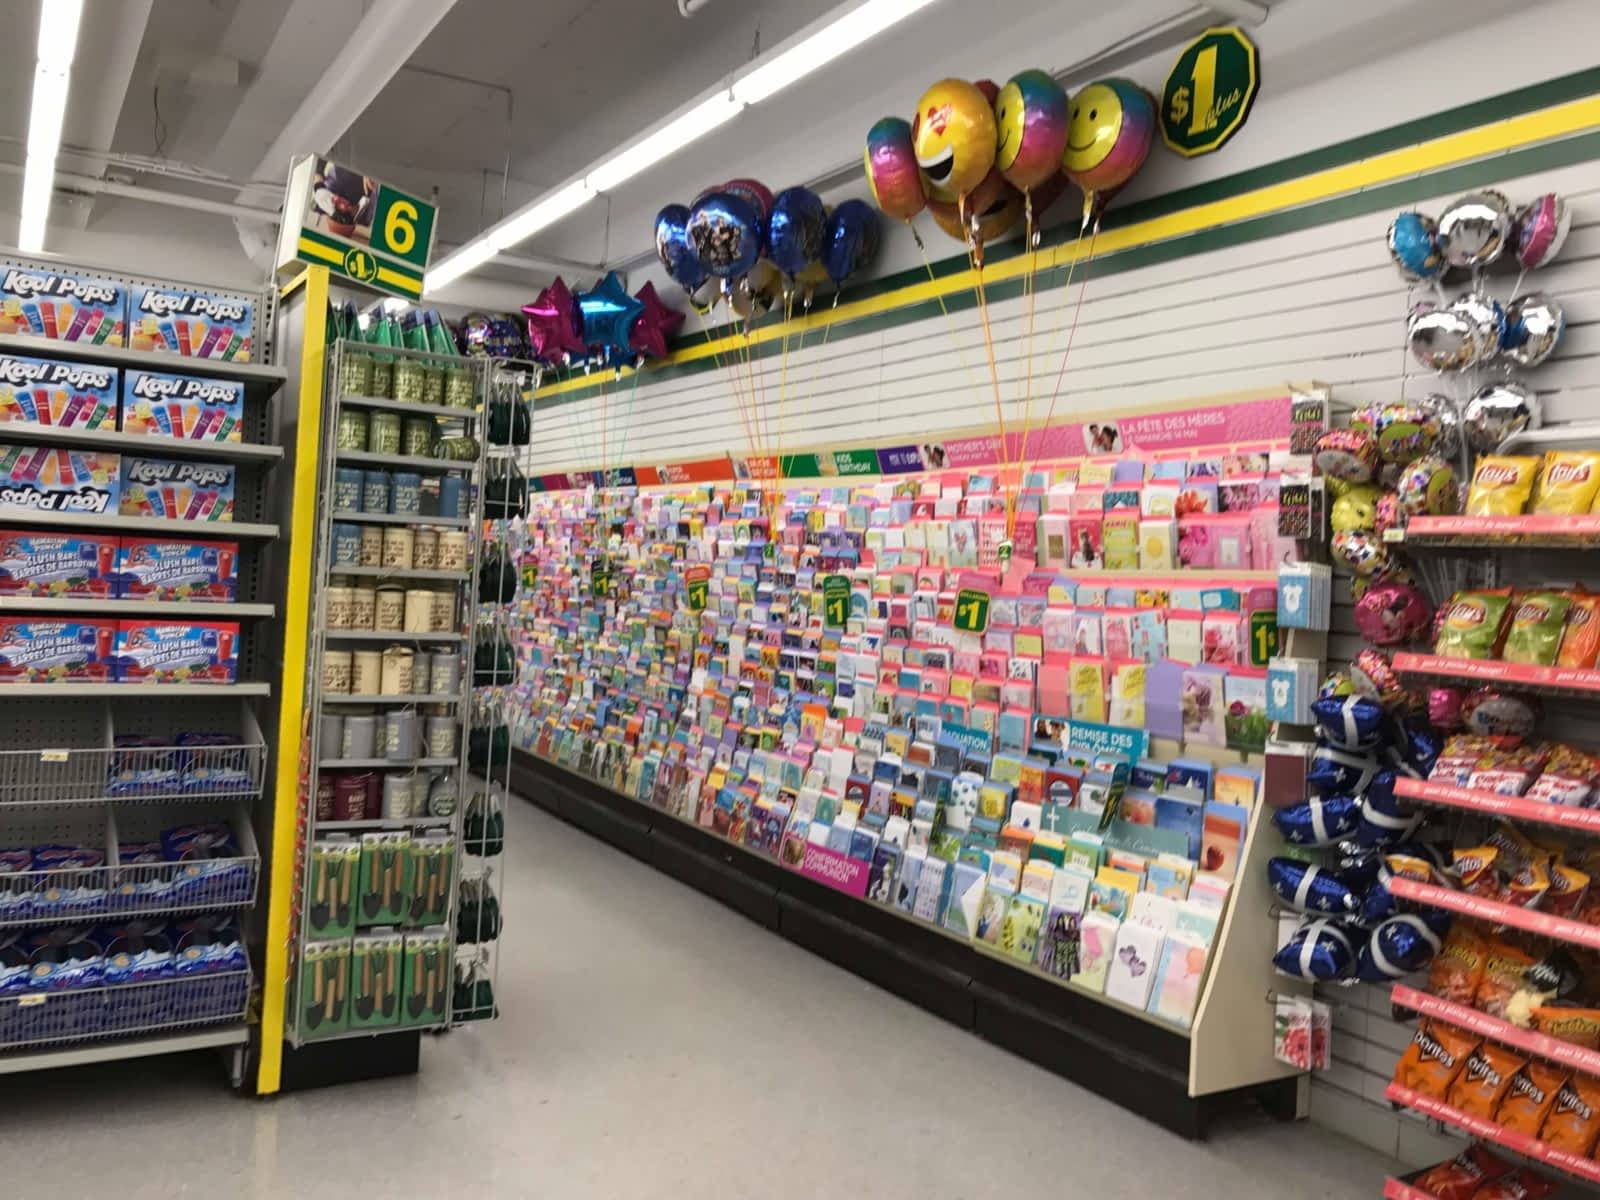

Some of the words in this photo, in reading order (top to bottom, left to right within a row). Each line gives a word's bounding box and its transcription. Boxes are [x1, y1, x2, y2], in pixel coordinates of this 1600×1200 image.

[1170, 43, 1217, 136] $1
[1205, 88, 1242, 130] plus
[384, 200, 418, 254] 6
[3, 270, 51, 293] Kool
[57, 278, 117, 303] Pops
[141, 290, 185, 310] Kool
[191, 296, 245, 320] Pops
[0, 359, 45, 381] Kool
[50, 365, 110, 391] Pops
[135, 375, 179, 396] Kool
[184, 382, 238, 404] Pops
[1122, 423, 1136, 434] LA
[1164, 415, 1186, 430] DES
[130, 460, 172, 481] Kool
[177, 464, 228, 485] Pops
[1, 488, 56, 510] Pops
[61, 489, 109, 512] Kool
[27, 552, 57, 568] SLUSH
[154, 558, 180, 573] SLUSH
[827, 598, 843, 624] $1
[958, 600, 981, 630] $1
[26, 638, 56, 653] SLUSH
[152, 641, 180, 656] SLUSH
[1071, 726, 1108, 745] REMISE
[1111, 733, 1133, 748] DES
[1414, 1030, 1455, 1068] Doritos
[1468, 1057, 1501, 1087] oritos
